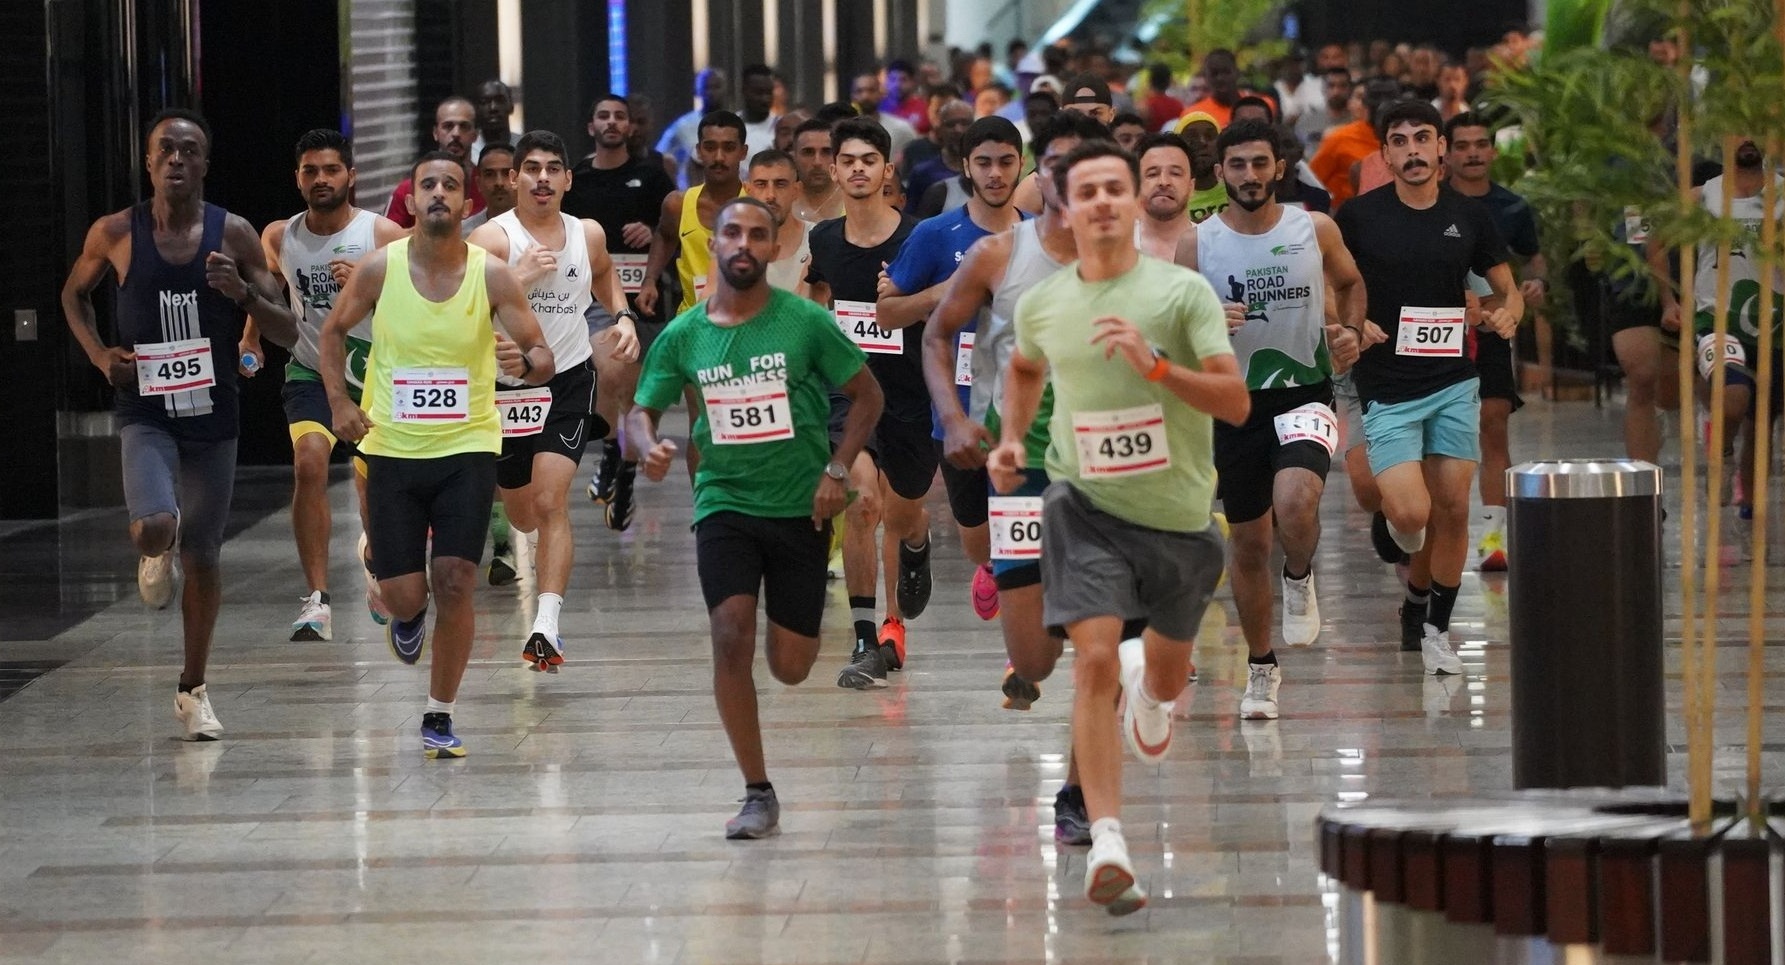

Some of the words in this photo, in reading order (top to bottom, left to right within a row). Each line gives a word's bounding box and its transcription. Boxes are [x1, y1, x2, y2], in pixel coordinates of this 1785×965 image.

[1246, 266, 1288, 278] PAKISTAN
[1247, 276, 1284, 291] ROAD
[159, 289, 198, 306] Next
[1248, 286, 1310, 304] RUNNERS
[1416, 326, 1454, 344] 507
[1705, 344, 1737, 362] 60
[157, 357, 201, 381] 495
[697, 363, 733, 384] RUN
[749, 352, 786, 372] FOR
[412, 388, 457, 408] 528
[507, 405, 543, 423] 443
[730, 404, 776, 428] 581
[1099, 431, 1152, 459] 439
